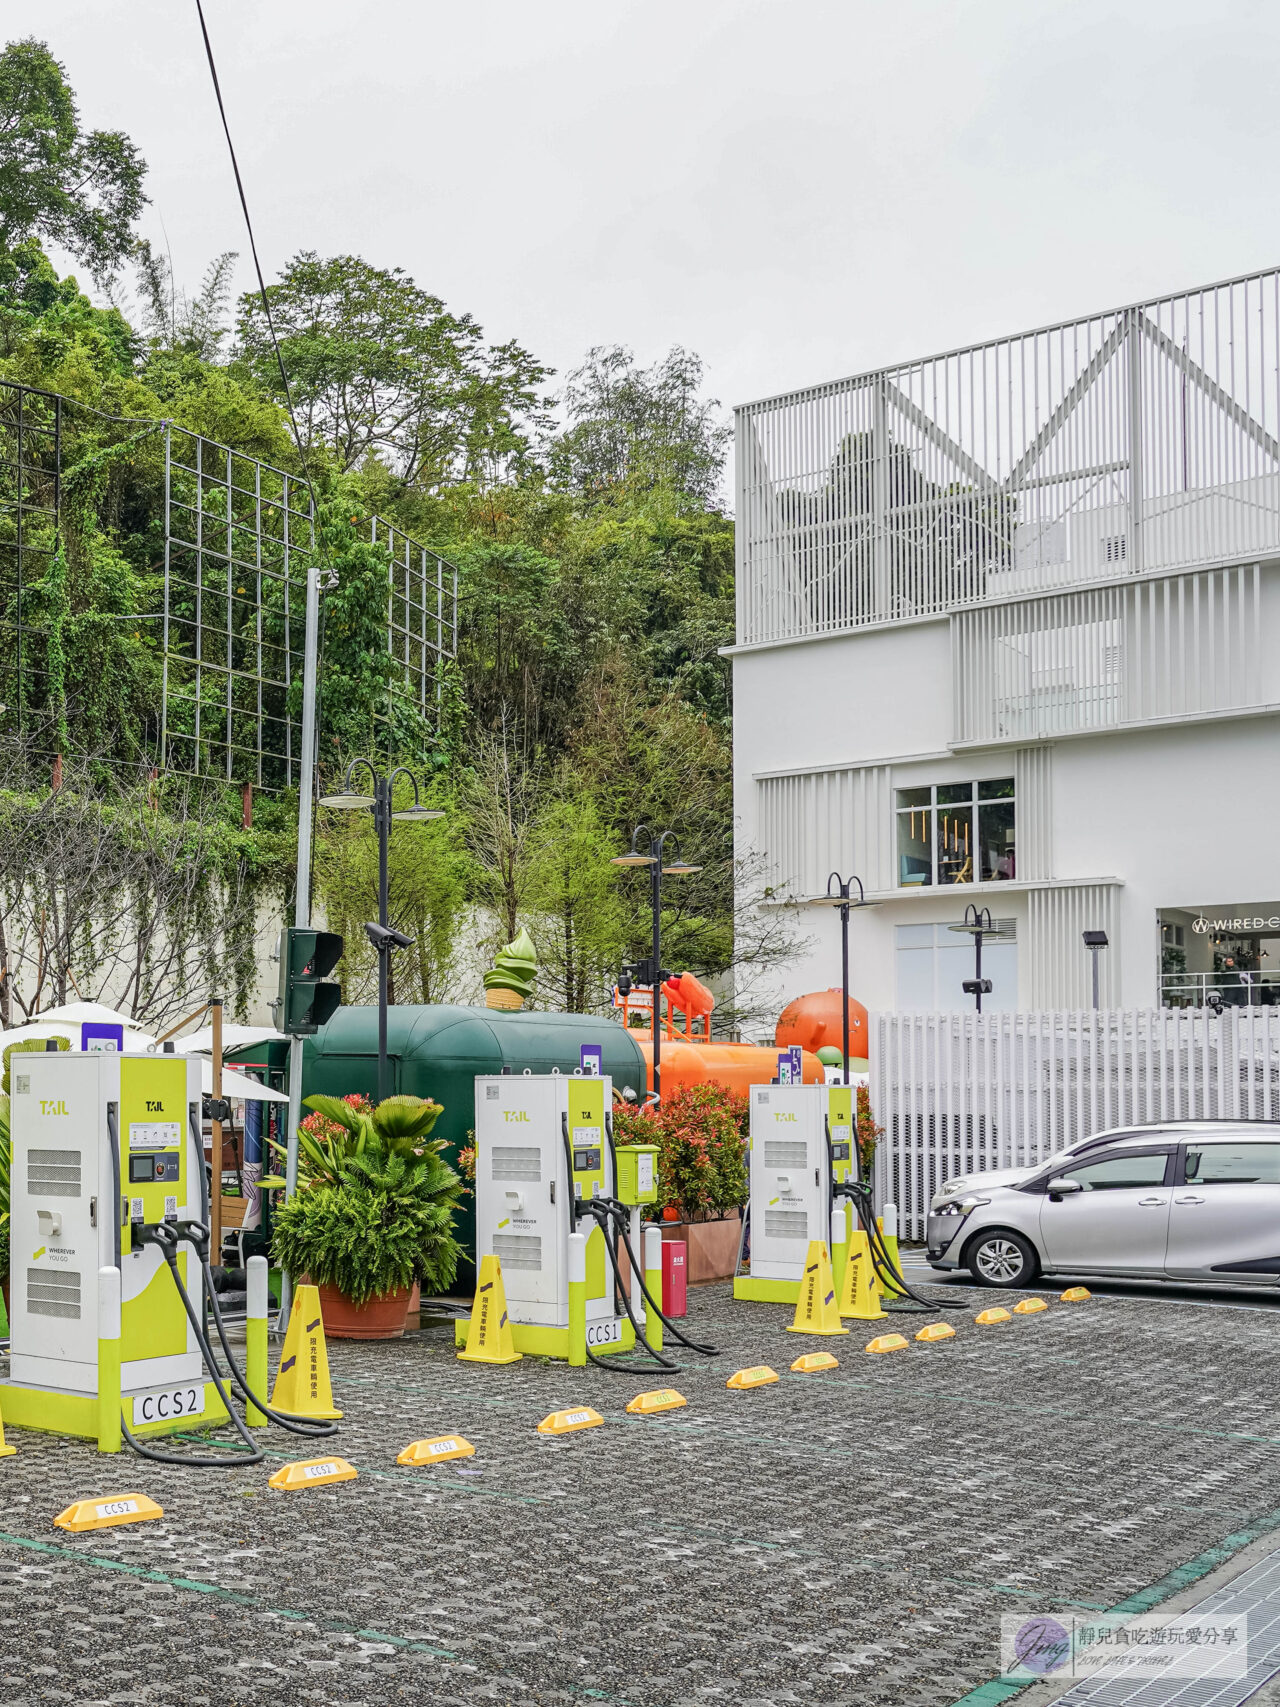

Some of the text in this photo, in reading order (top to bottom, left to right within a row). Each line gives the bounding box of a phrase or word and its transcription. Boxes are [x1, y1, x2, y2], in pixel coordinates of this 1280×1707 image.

[39, 1100, 70, 1116] TAIL
[503, 1111, 531, 1122] TAIL
[49, 1247, 76, 1255] WHEREVER
[587, 1323, 618, 1344] CCS1
[142, 1389, 197, 1420] CCS2
[434, 1441, 453, 1453] CCS2
[310, 1464, 332, 1476] CCS2
[104, 1502, 131, 1515] CCS2
